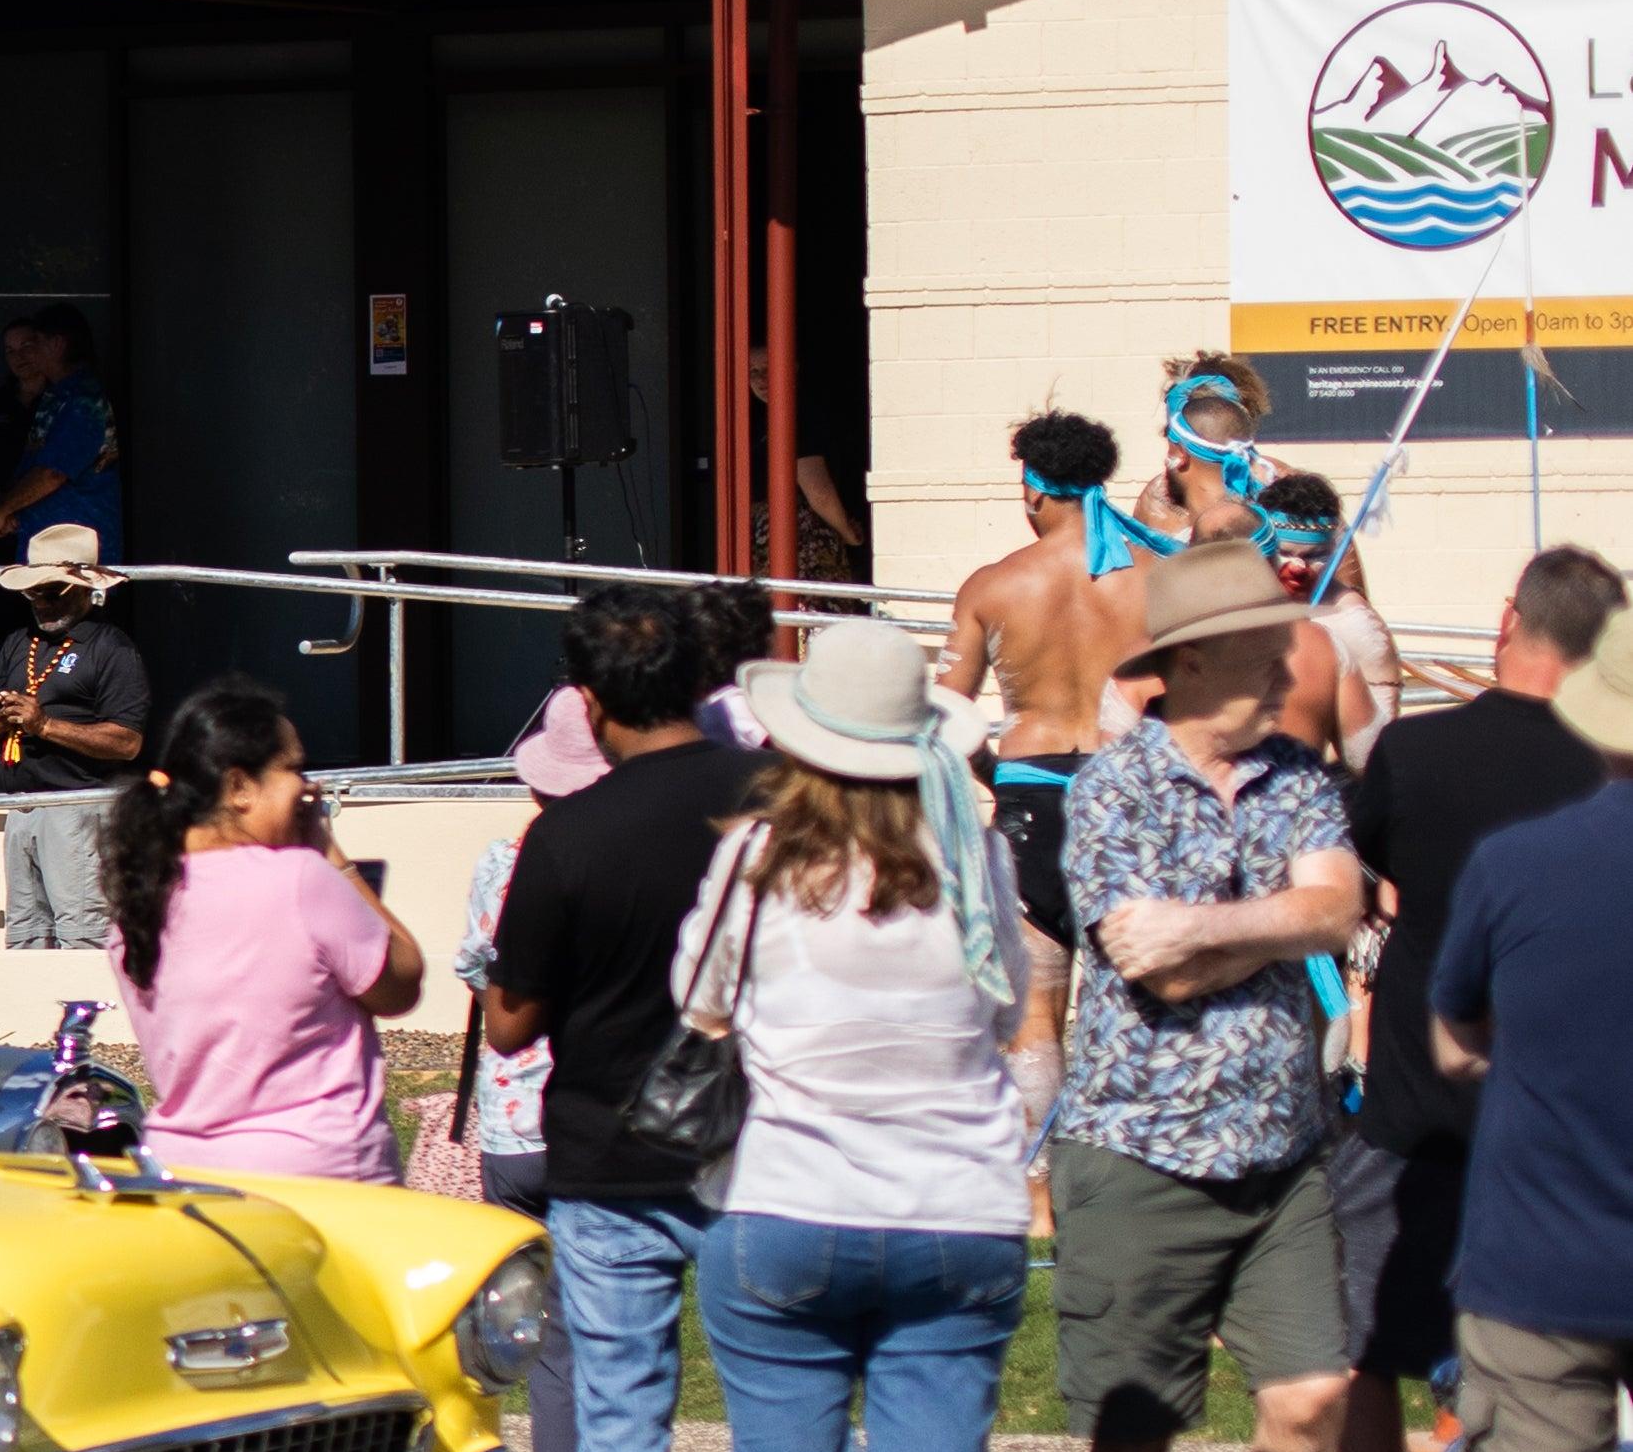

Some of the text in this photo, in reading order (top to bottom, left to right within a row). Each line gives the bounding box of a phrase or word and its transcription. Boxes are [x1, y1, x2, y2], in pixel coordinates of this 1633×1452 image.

[1310, 316, 1368, 335] FREE
[1463, 313, 1518, 336] Open
[1586, 313, 1604, 330] to
[1318, 366, 1328, 375] AN
[1329, 365, 1372, 375] EMERGENCY
[1373, 365, 1391, 374] CALL
